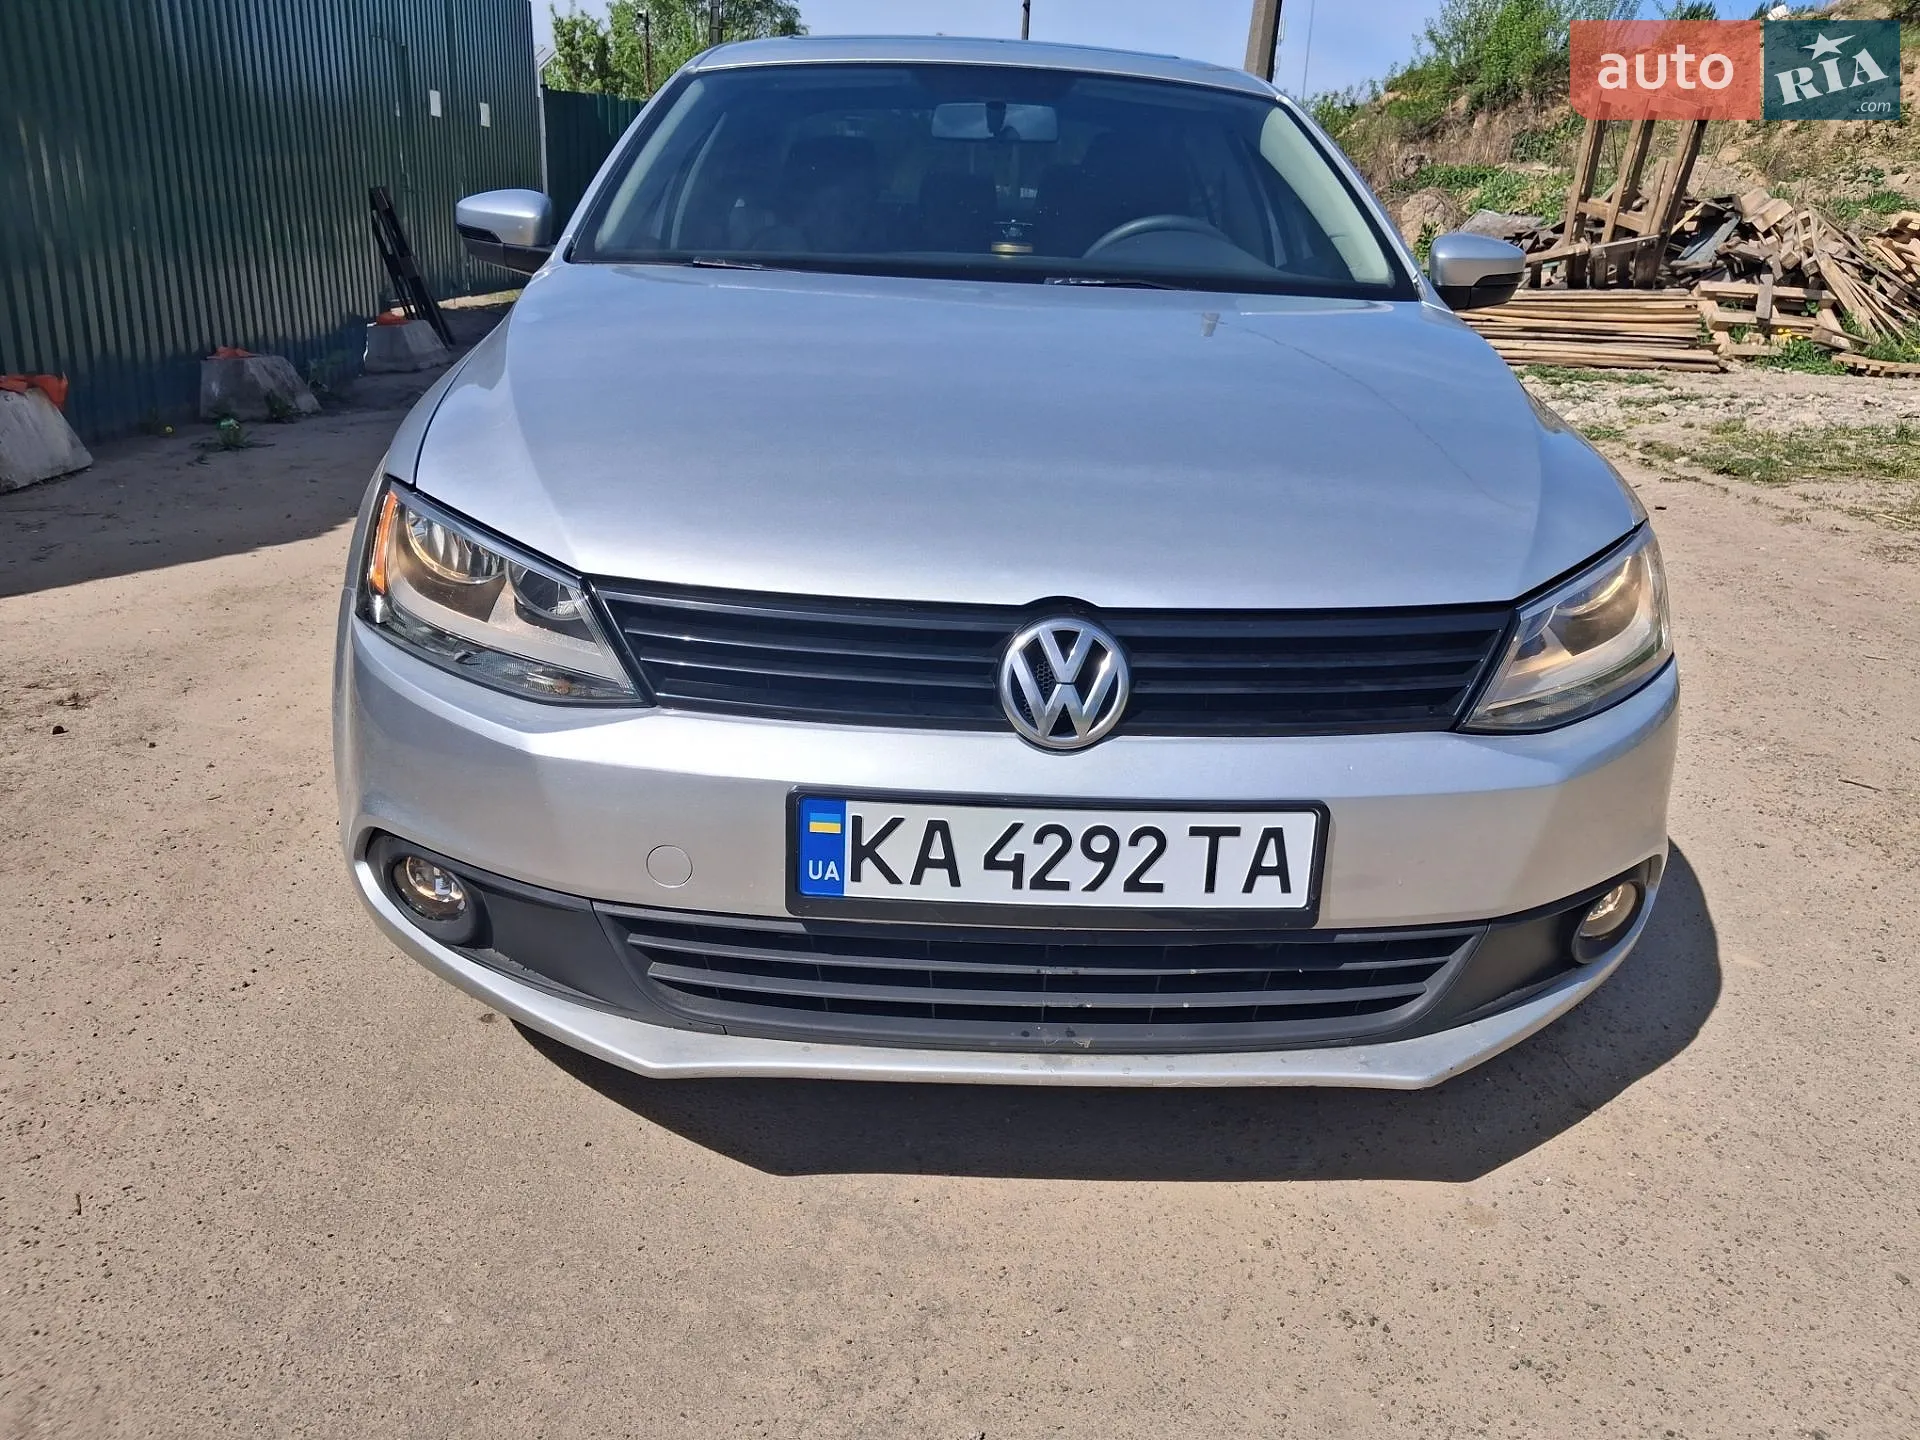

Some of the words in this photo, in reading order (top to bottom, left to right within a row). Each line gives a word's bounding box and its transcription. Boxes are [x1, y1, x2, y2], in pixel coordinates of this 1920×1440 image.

[807, 861, 840, 881] UA
[850, 815, 961, 887] KA
[983, 821, 1168, 893] 4292
[1188, 826, 1292, 893] TA
